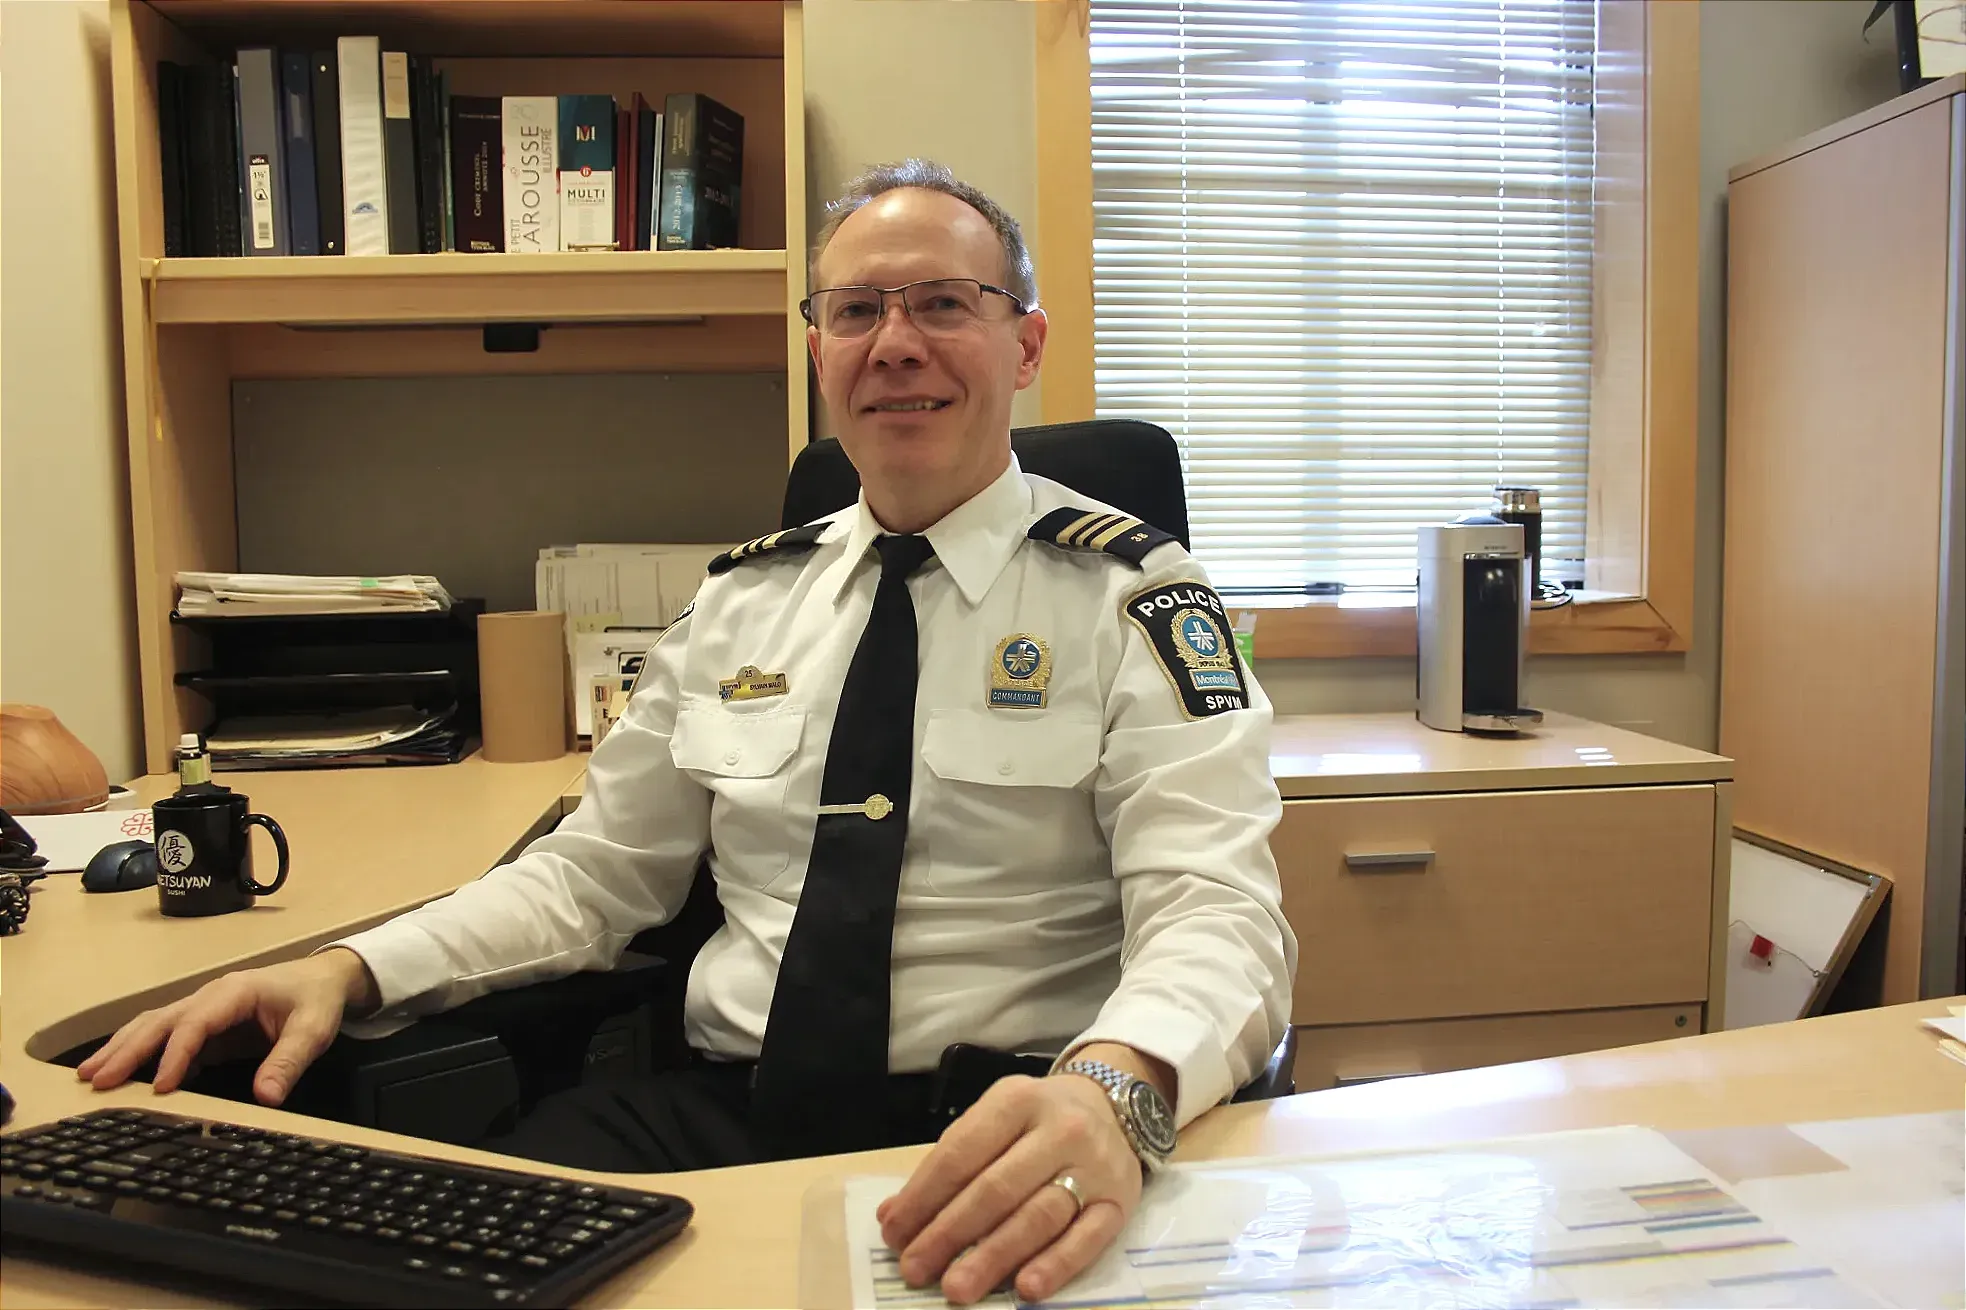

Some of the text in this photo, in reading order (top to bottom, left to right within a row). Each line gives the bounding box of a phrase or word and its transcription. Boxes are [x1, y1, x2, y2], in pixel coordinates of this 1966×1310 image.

[520, 125, 541, 252] AROUSSE
[567, 188, 605, 198] MULTI
[1137, 589, 1223, 617] POLICE
[992, 691, 1040, 702] COMMANDANT
[1205, 694, 1243, 710] SPVM
